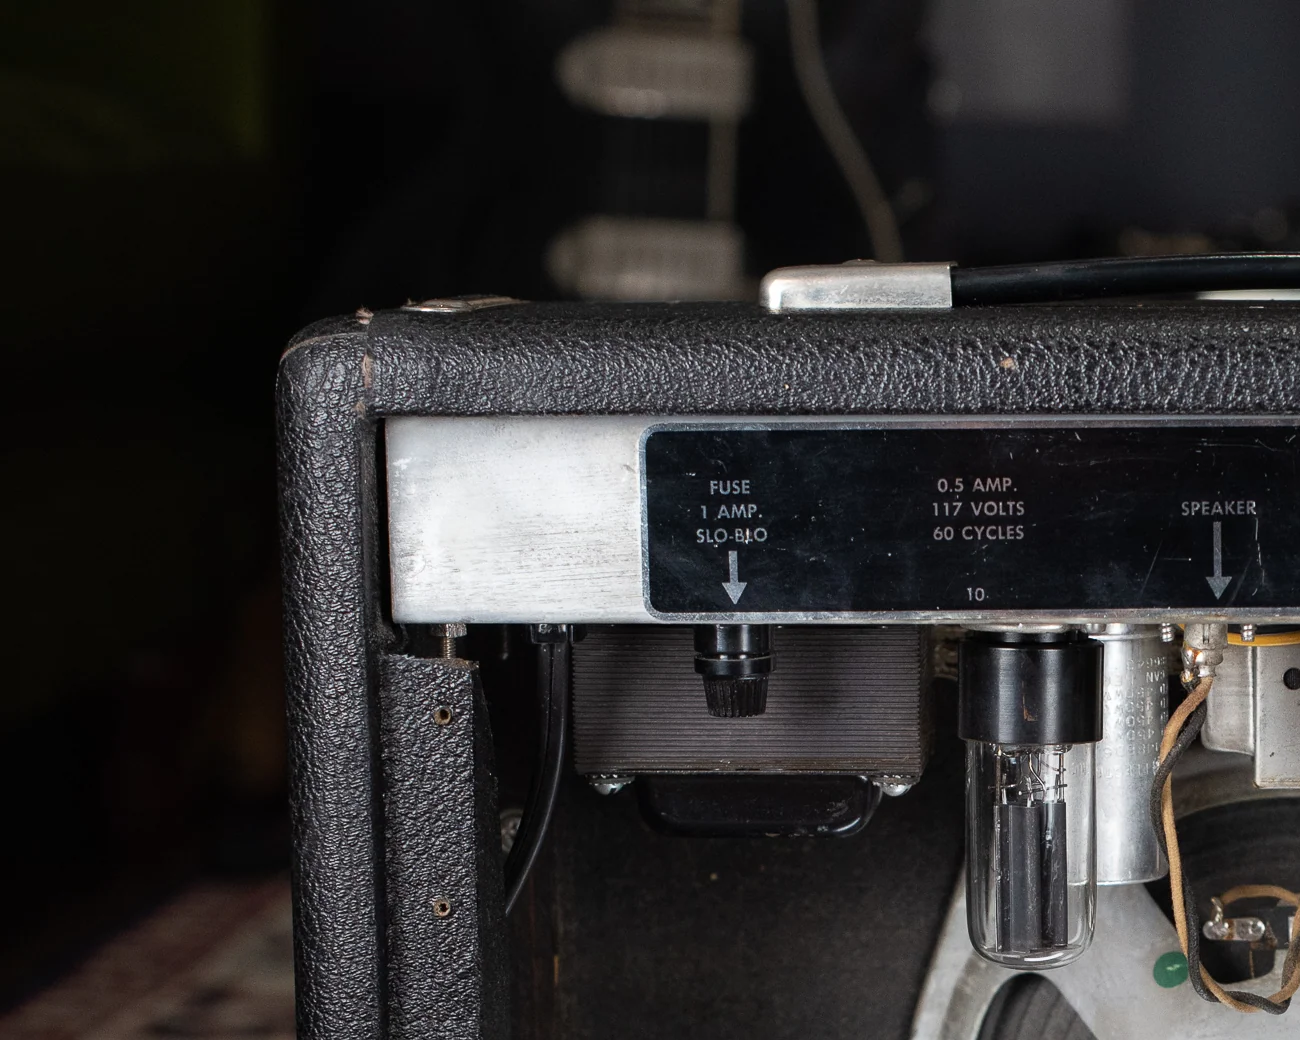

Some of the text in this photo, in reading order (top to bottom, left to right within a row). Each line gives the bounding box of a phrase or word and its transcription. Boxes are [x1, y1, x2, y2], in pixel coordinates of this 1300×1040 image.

[709, 480, 751, 495] FUSE
[937, 477, 1018, 494] 0.5 AMP.
[700, 504, 763, 519] 1 AMP.
[932, 501, 1026, 517] 117 VOLTS
[1181, 501, 1257, 516] SPEAKER
[695, 528, 769, 545] SLO-BLO
[932, 525, 1025, 541] 60 CYCLES
[966, 587, 986, 602] 10
